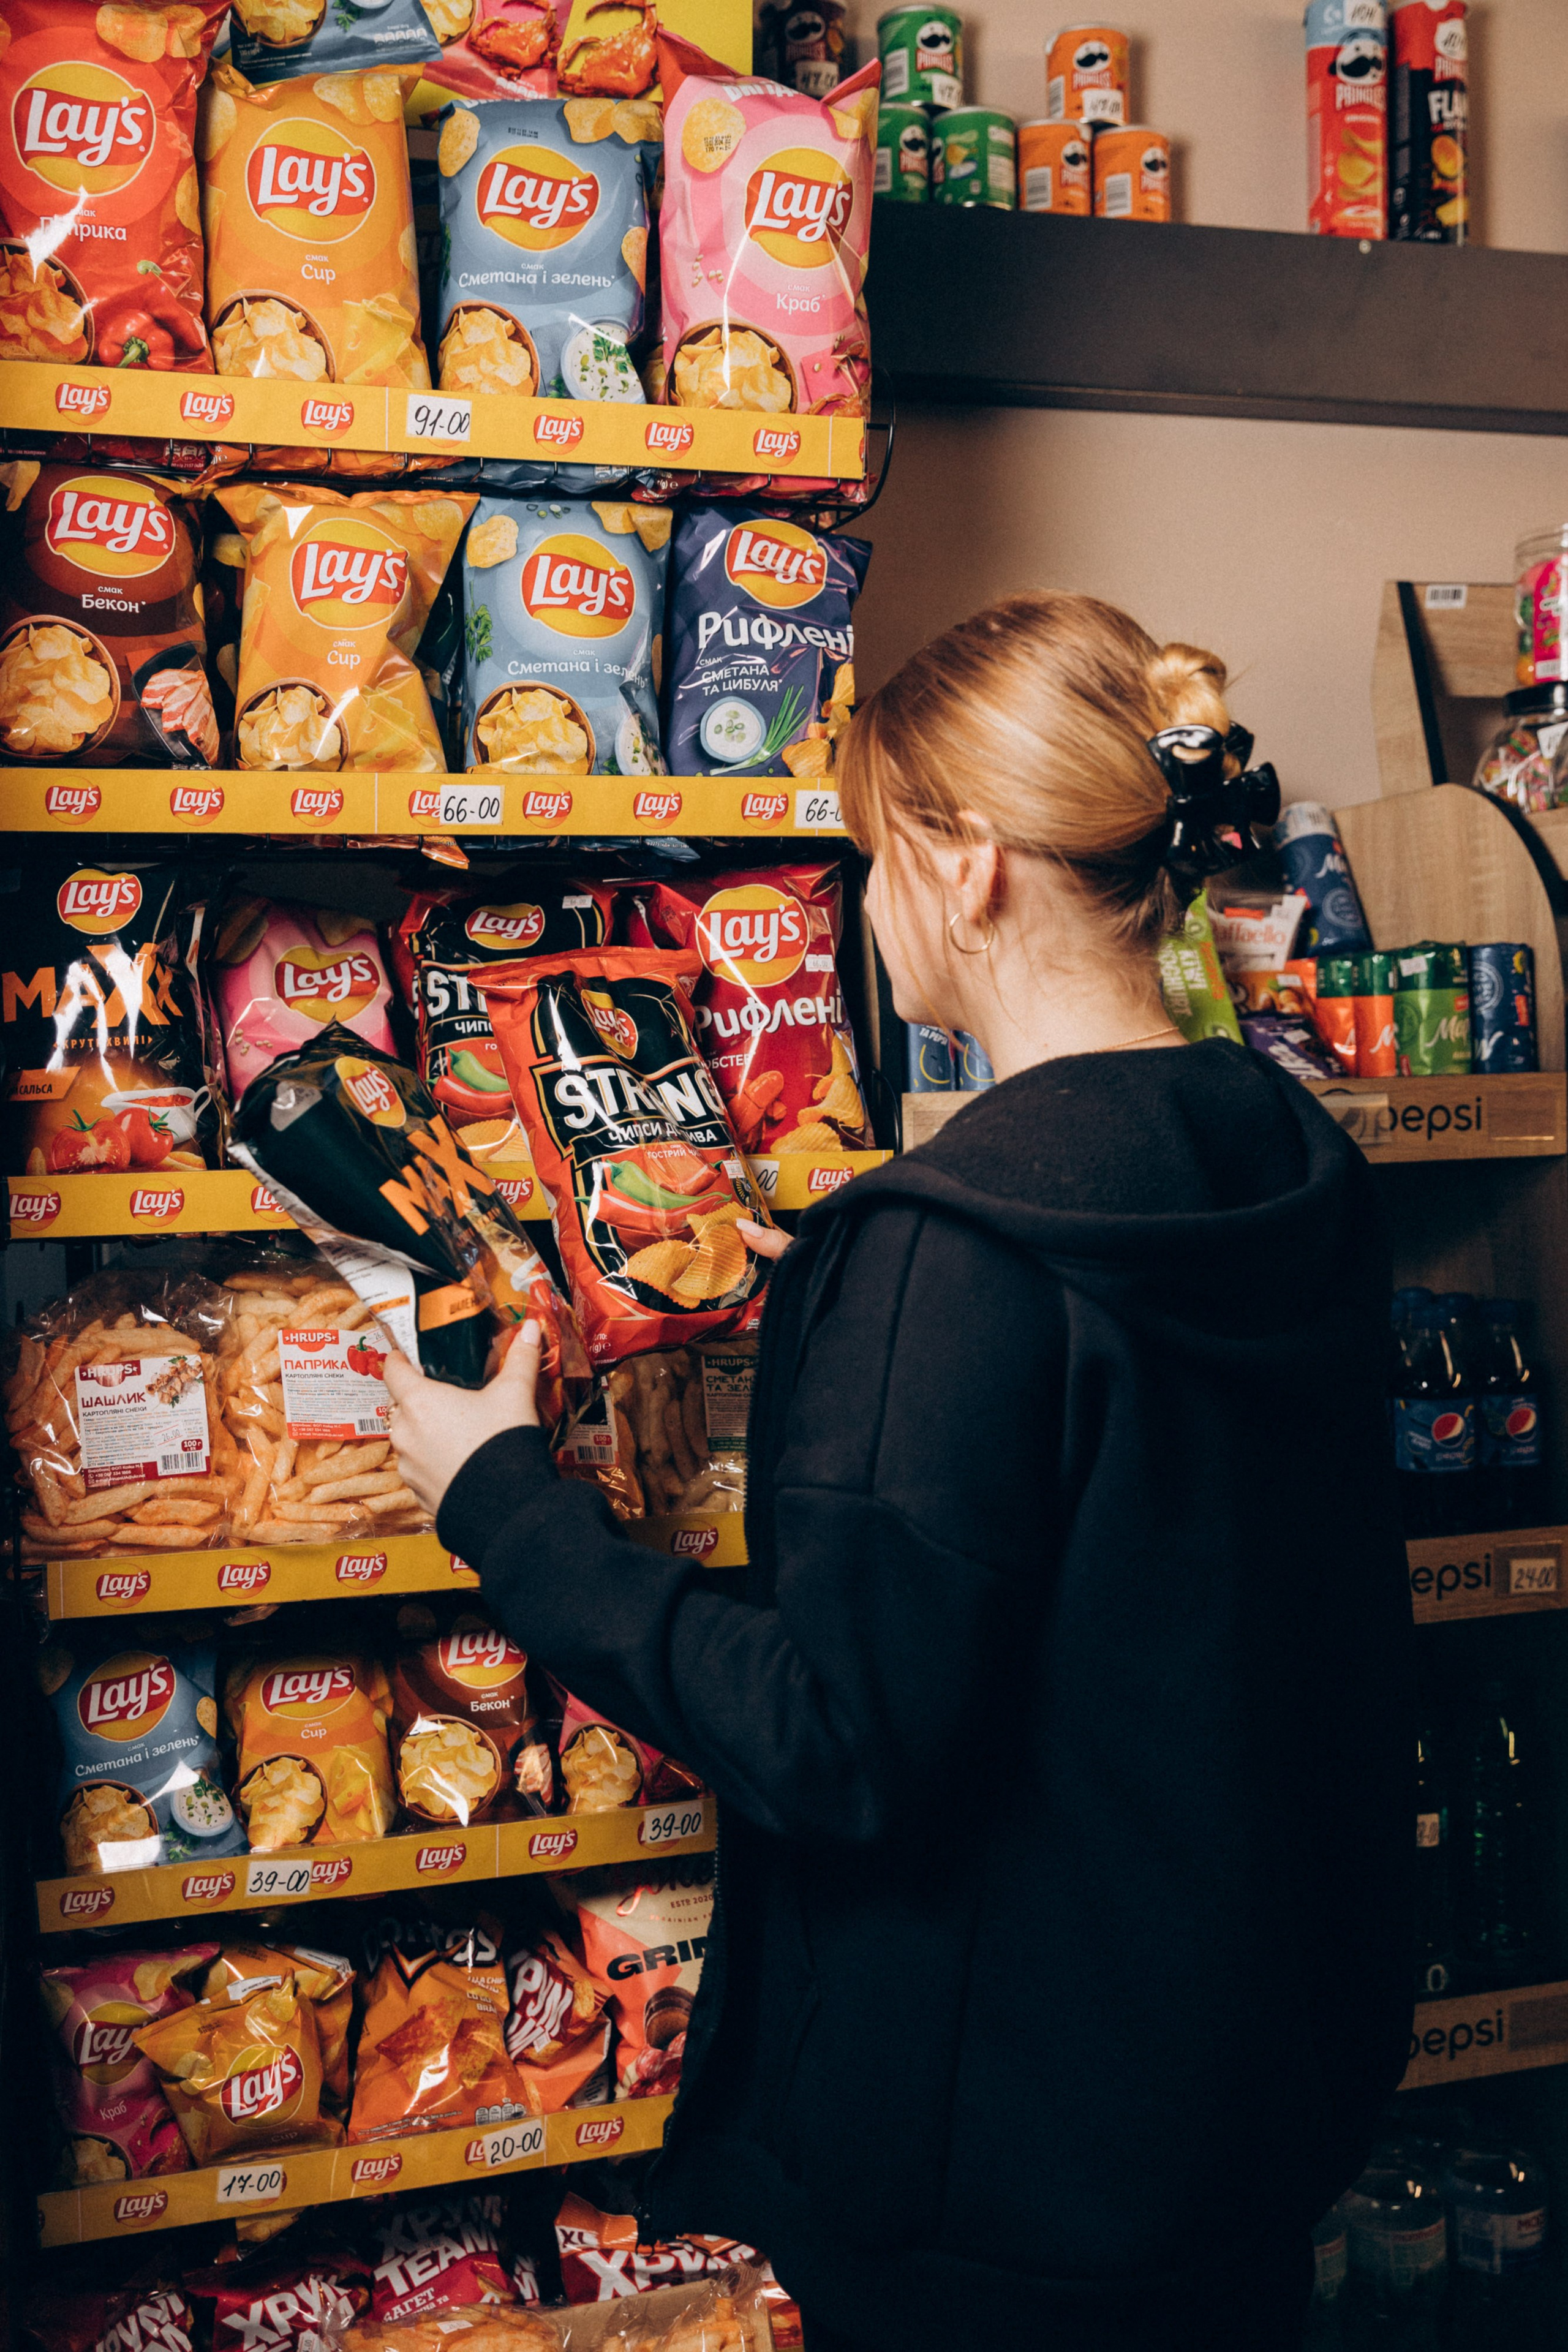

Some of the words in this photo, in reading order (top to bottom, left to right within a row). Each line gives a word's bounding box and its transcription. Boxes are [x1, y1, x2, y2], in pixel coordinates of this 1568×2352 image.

[24, 90, 147, 167] Lay's
[257, 146, 368, 217] Lay's
[482, 162, 594, 230] Lay's
[753, 171, 851, 243] Lay's
[39, 216, 128, 243] Пприка
[301, 263, 336, 284] Сир
[458, 272, 537, 287] Сметана
[541, 270, 548, 285] і
[551, 271, 612, 288] зелень
[775, 294, 821, 313] Краб
[58, 383, 111, 414] Lay's
[183, 391, 233, 423] Lay's
[304, 399, 352, 431] Lay's
[537, 412, 583, 447] Lay's
[647, 420, 693, 452] Lay's
[755, 428, 800, 458] Lay's
[53, 492, 169, 553] Lay's
[732, 530, 824, 584] Lay's
[300, 543, 405, 604] Lay's
[530, 555, 629, 616] Lay's
[81, 594, 140, 613] Бекон
[698, 611, 854, 657] Рифлені
[326, 649, 361, 669] Сир
[507, 659, 590, 676] Сметана
[594, 658, 600, 673] і
[701, 664, 770, 684] СМЕТАНА
[702, 682, 721, 696] ТА
[723, 679, 778, 695] ЦИБУЛЯ
[48, 785, 100, 815] Lay's
[173, 786, 223, 816] Lay's
[294, 788, 342, 817] Lay's
[443, 795, 500, 823] 66-00
[525, 791, 571, 819] Lay's
[636, 793, 681, 821] Lay's
[744, 793, 788, 821] Lay's
[64, 877, 137, 917] Lay's
[470, 911, 540, 941] Lay's
[707, 903, 801, 963] Lay's
[284, 956, 372, 1001] Lay's
[694, 988, 843, 1042] Рифлені
[19, 1083, 53, 1095] САЛЬСА
[608, 1123, 663, 1144] ЧИПСИ
[647, 1147, 687, 1159] ГОСТРИЙ
[491, 1177, 532, 1205] ay's
[810, 1167, 855, 1193] Lay's
[134, 1189, 182, 1217] Lay's
[290, 1332, 332, 1343] HRUPS
[284, 1359, 349, 1370] ПАПРИКА
[712, 1358, 750, 1366] HRUPS
[81, 1392, 146, 1408] ШАШЛИК
[673, 1529, 718, 1555] Lay's
[220, 1562, 270, 1591] Lay's
[337, 1553, 387, 1581] Lay's
[1411, 1553, 1491, 1600] epsi
[99, 1570, 149, 1600] Lay's
[88, 1662, 172, 1725] Lay's
[268, 1665, 351, 1706] Lay's
[469, 1697, 511, 1713] Бекон
[300, 1725, 327, 1740] Сир
[75, 1751, 143, 1777] Сметана
[145, 1746, 149, 1760] і
[151, 1736, 196, 1758] зелень
[649, 1812, 703, 1841] 39-00
[418, 1844, 466, 1870] Lay's
[531, 1830, 576, 1856] Lay's
[184, 1871, 234, 1899] Lay's
[249, 1869, 310, 1893] 39-00
[63, 1887, 113, 1913] Lay's
[693, 1894, 714, 1904] 2020
[231, 2052, 300, 2119] Lay's
[100, 2100, 127, 2120] Краб
[578, 2116, 623, 2145] Lay's
[490, 2127, 542, 2165] 20-00
[354, 2154, 401, 2182] Lay's
[223, 2169, 281, 2198] 17-00
[116, 2192, 167, 2220] Lay's
